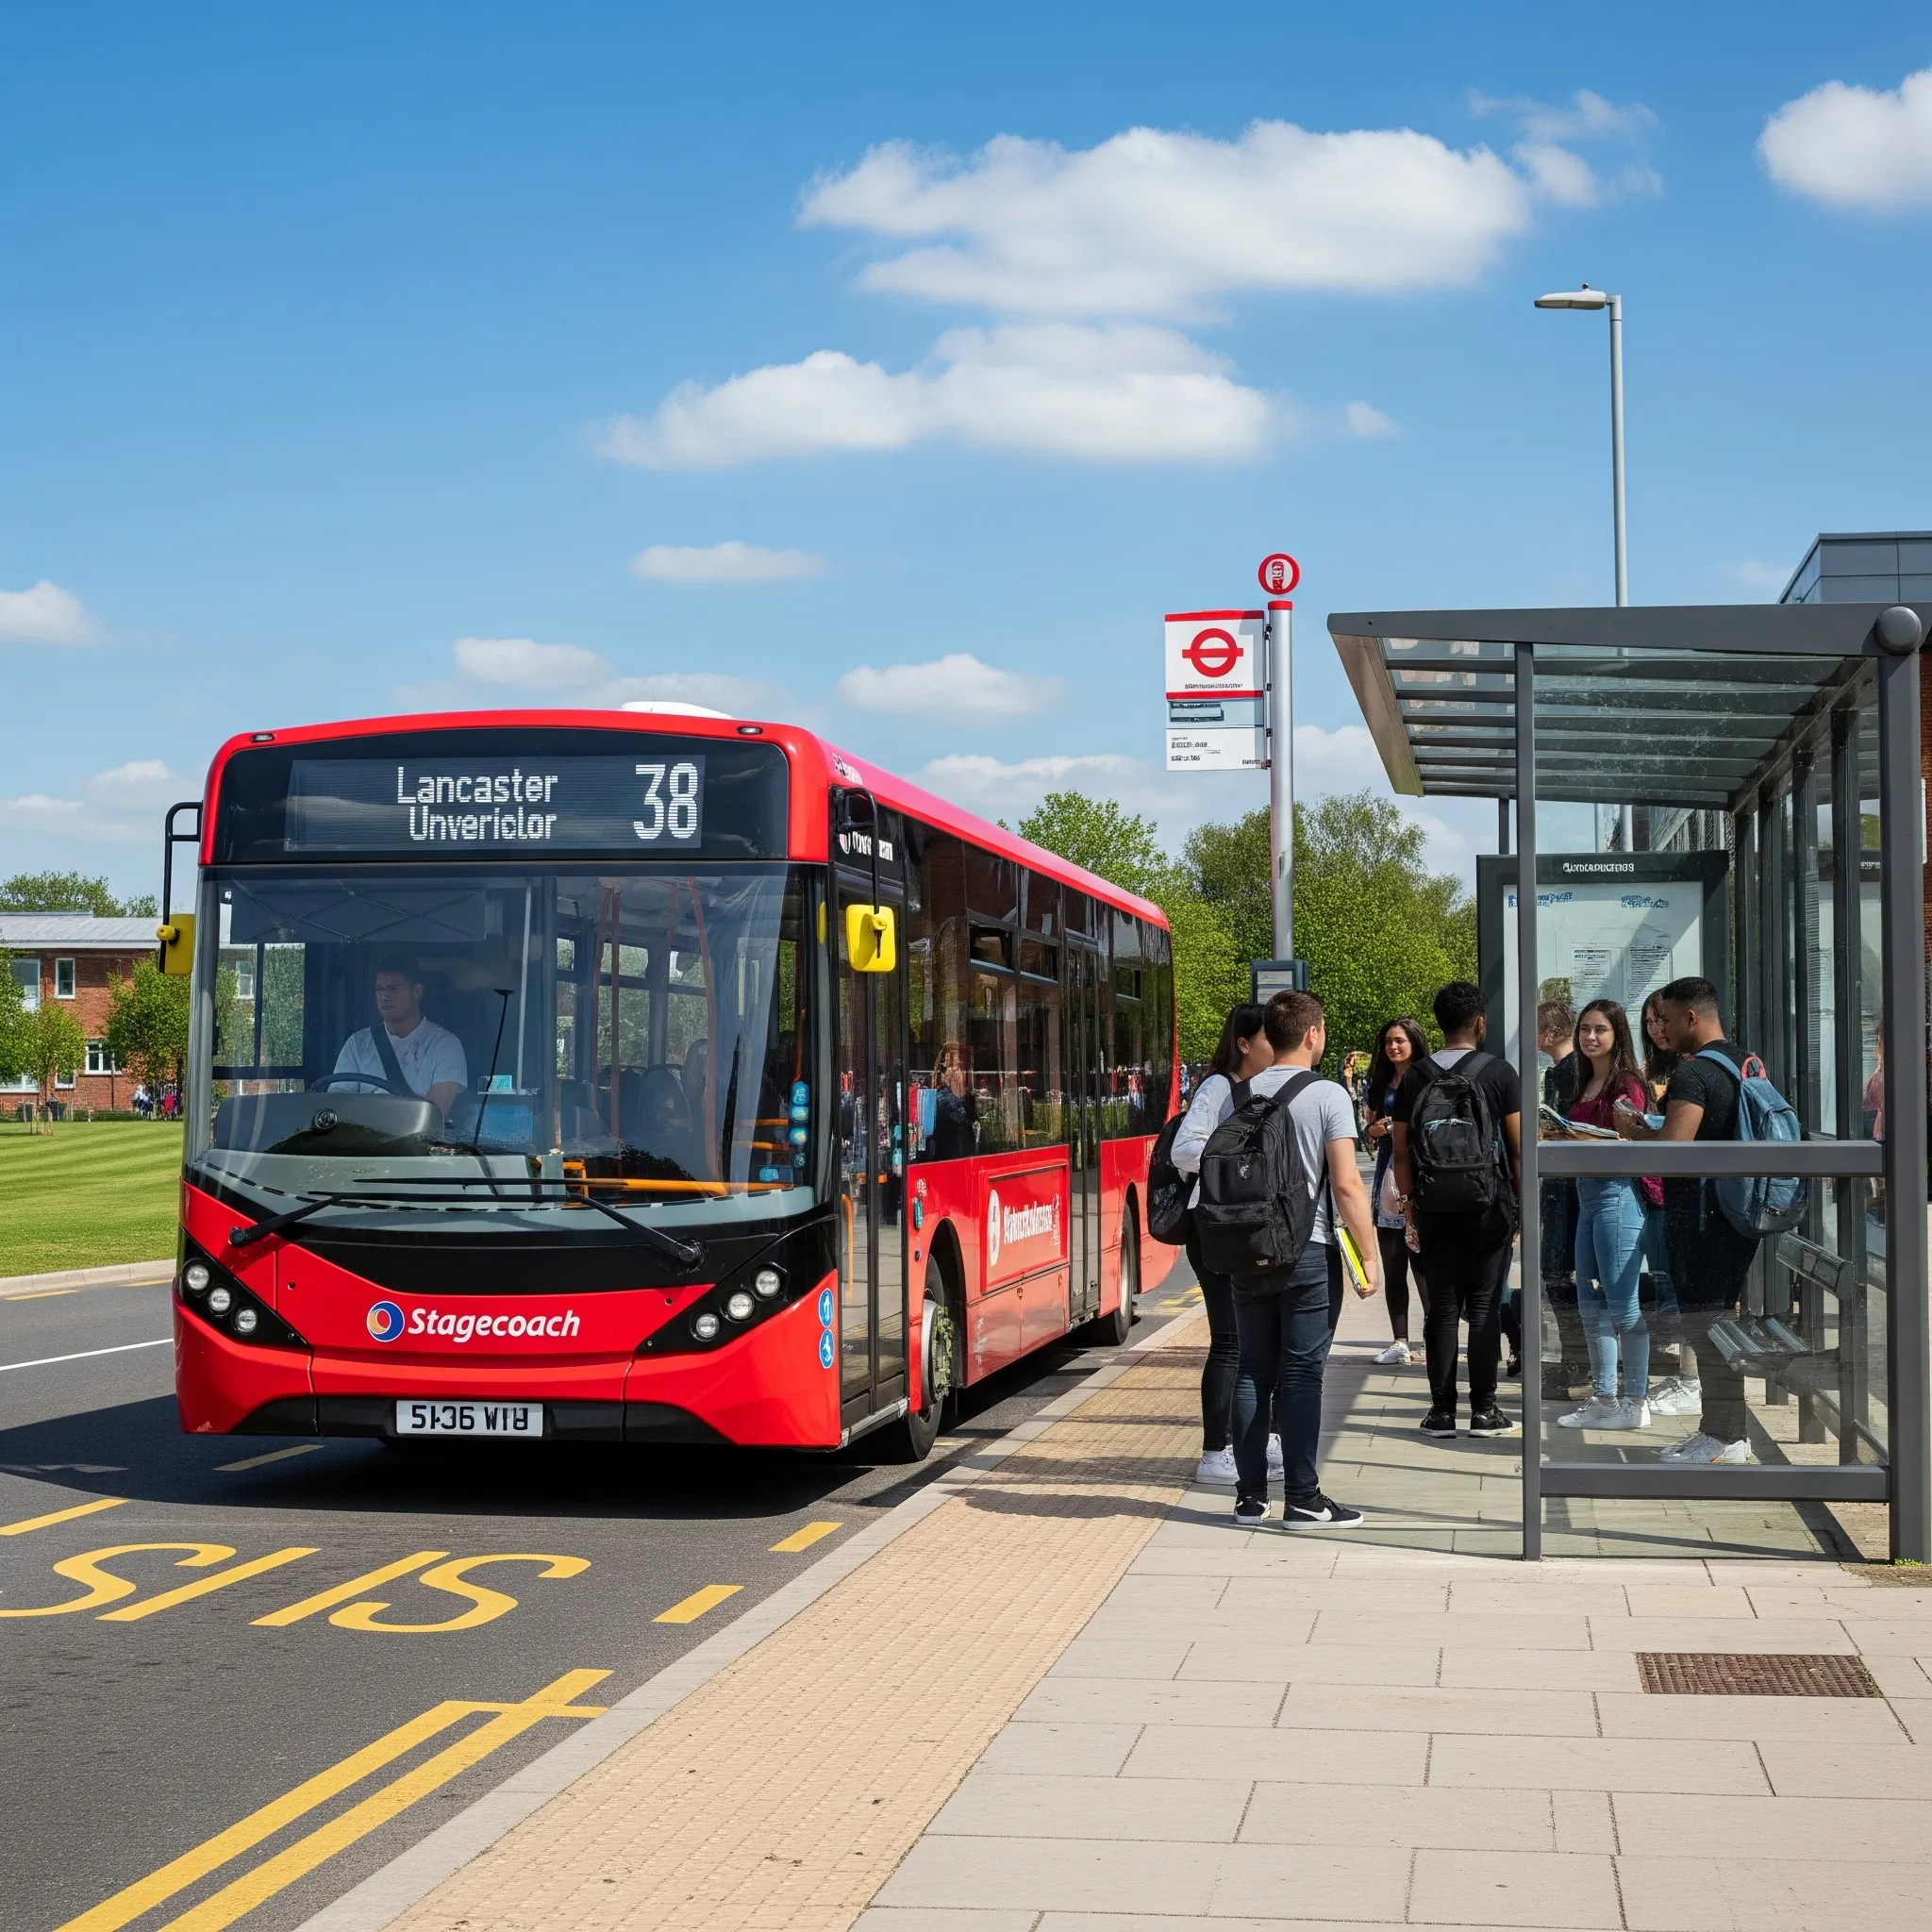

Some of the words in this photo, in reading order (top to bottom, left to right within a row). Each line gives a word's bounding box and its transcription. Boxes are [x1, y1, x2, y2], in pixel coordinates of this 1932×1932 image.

[398, 766, 558, 803] Lancaster
[634, 762, 698, 840] 38
[408, 1307, 580, 1343] Stagecoach
